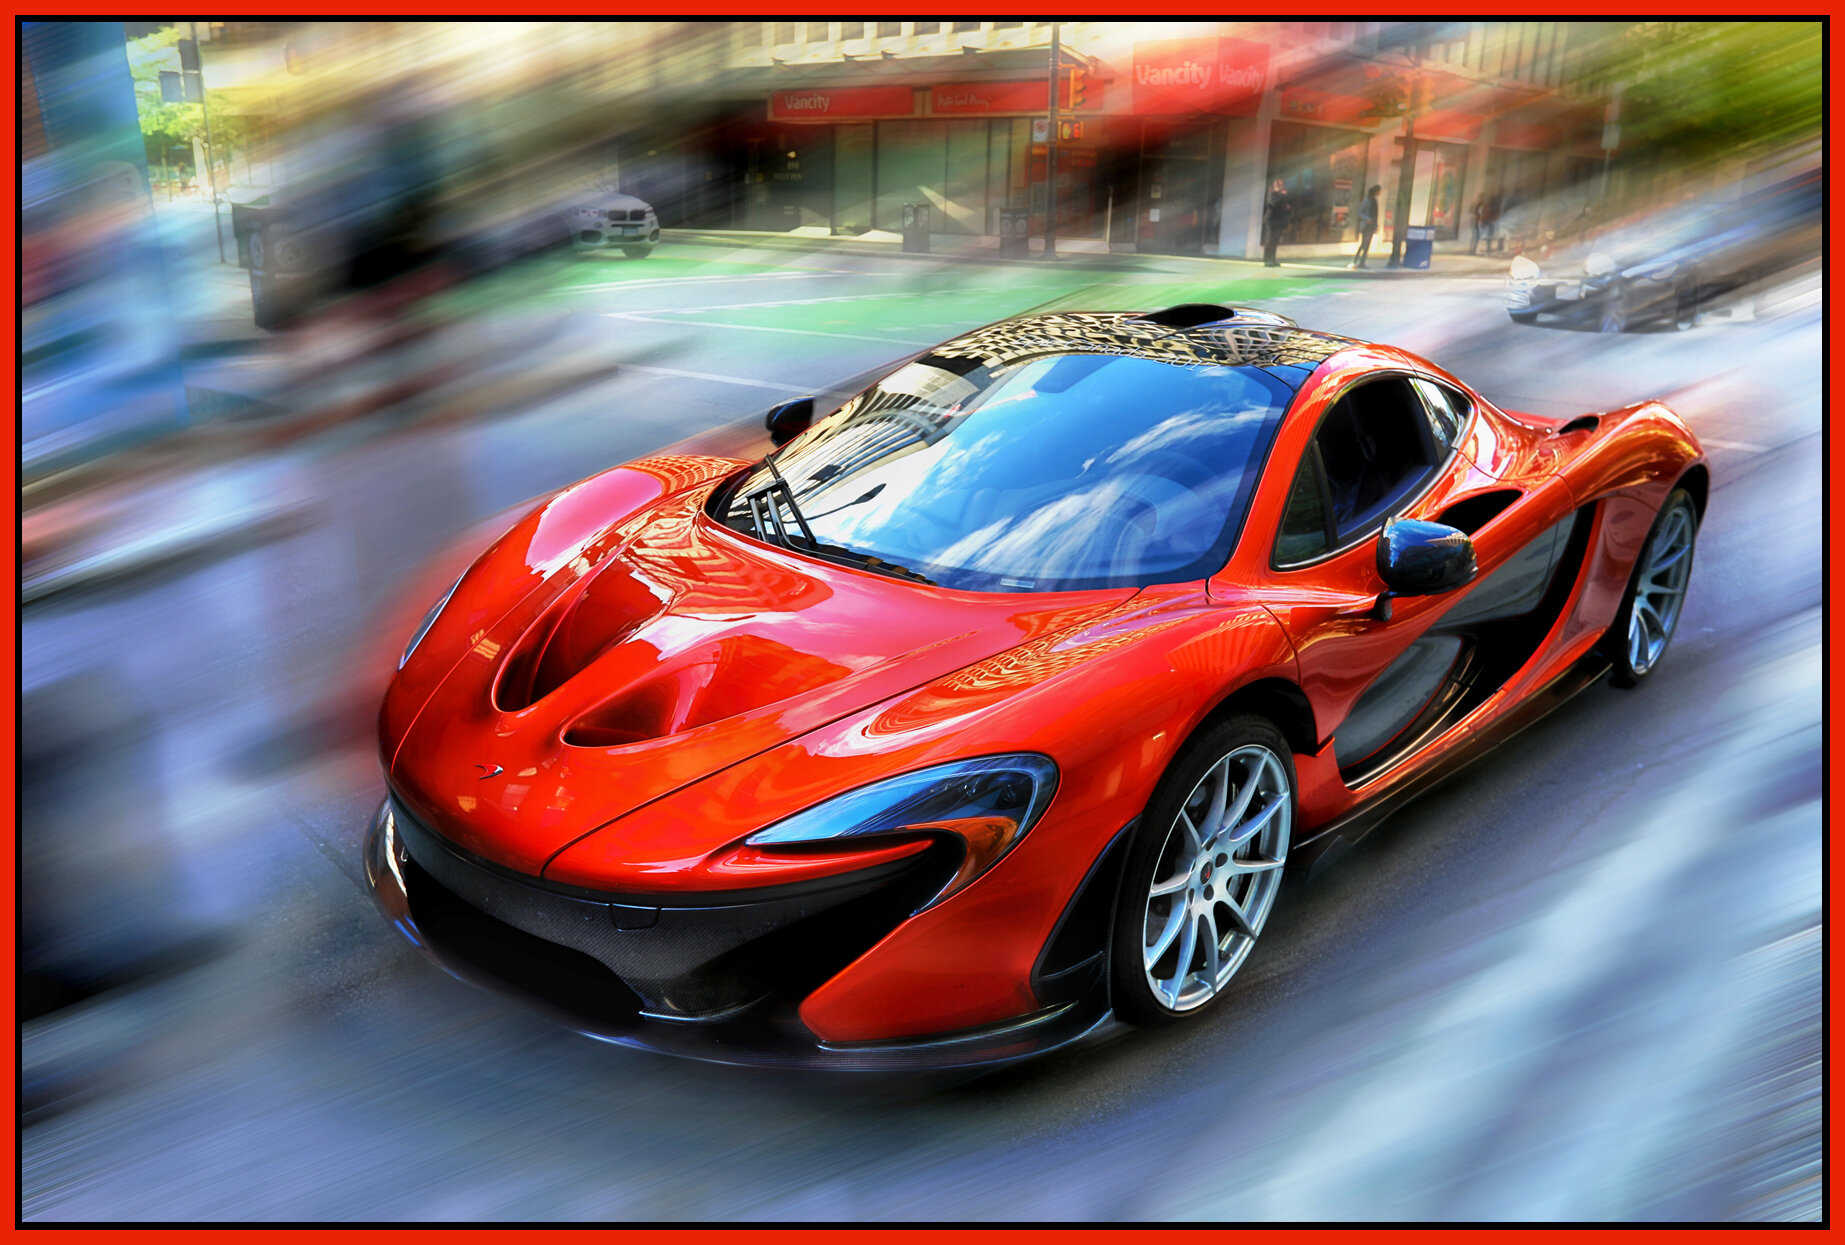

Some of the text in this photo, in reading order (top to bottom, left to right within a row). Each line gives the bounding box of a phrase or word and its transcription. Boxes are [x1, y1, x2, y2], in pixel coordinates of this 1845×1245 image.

[1135, 61, 1212, 90] Vancity
[1219, 63, 1265, 94] Vancity
[784, 93, 830, 113] Vancity
